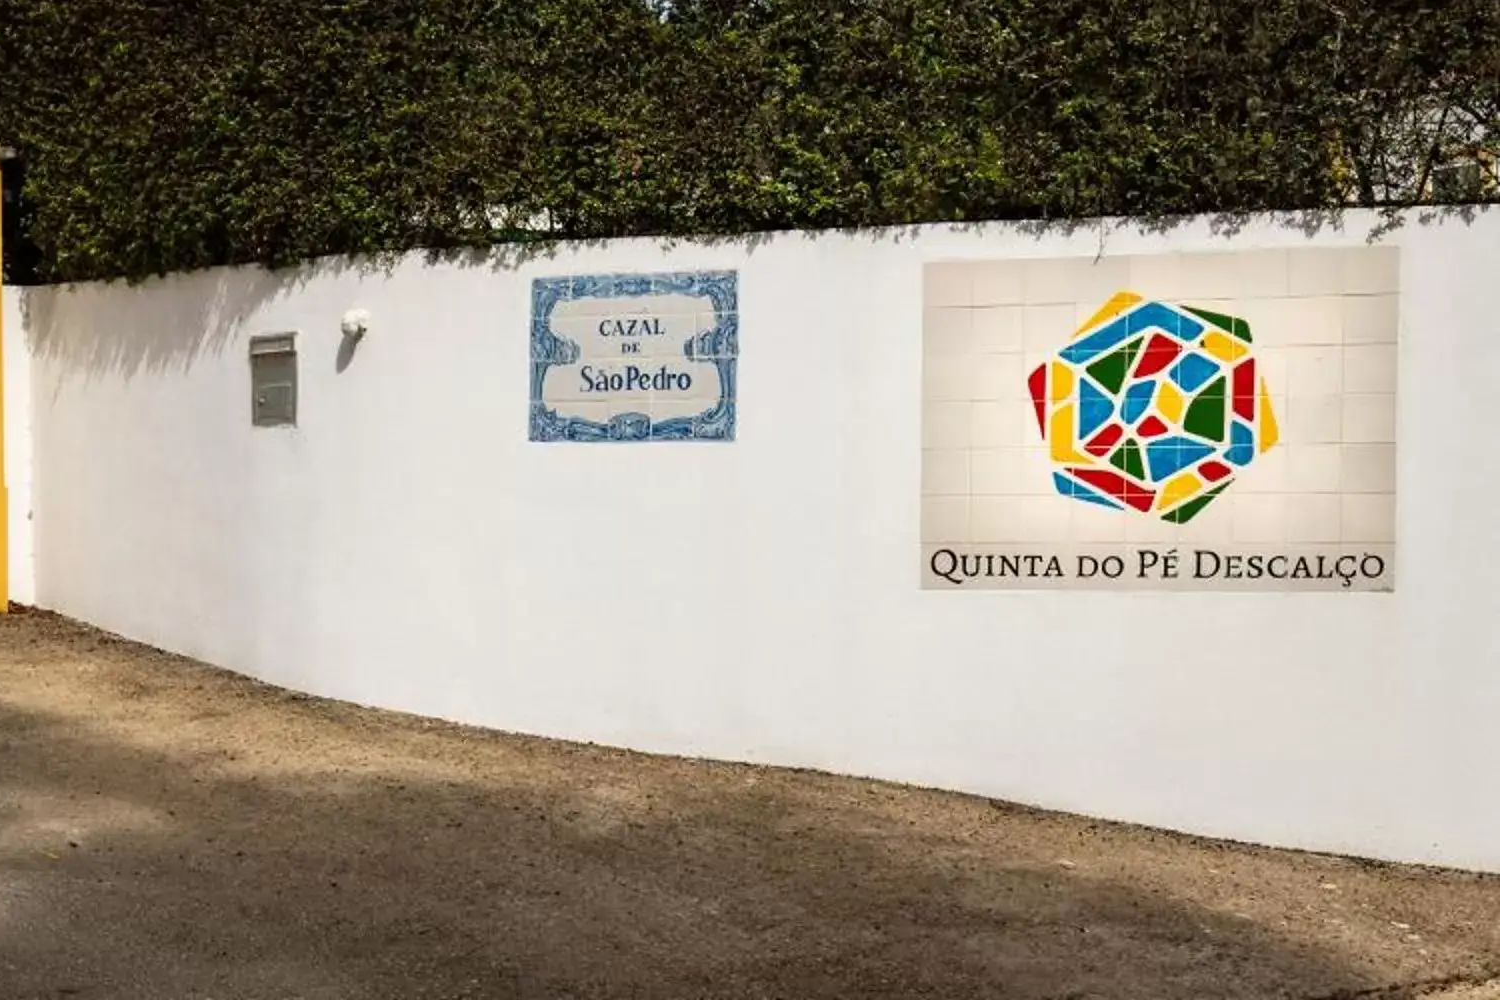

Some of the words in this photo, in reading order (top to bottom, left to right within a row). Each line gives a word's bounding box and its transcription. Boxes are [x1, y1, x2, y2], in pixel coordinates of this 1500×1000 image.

[599, 318, 666, 337] CAZAL
[621, 342, 641, 354] DE
[579, 365, 623, 392] São
[625, 364, 692, 391] Pedro
[930, 549, 1064, 585] QUINTA
